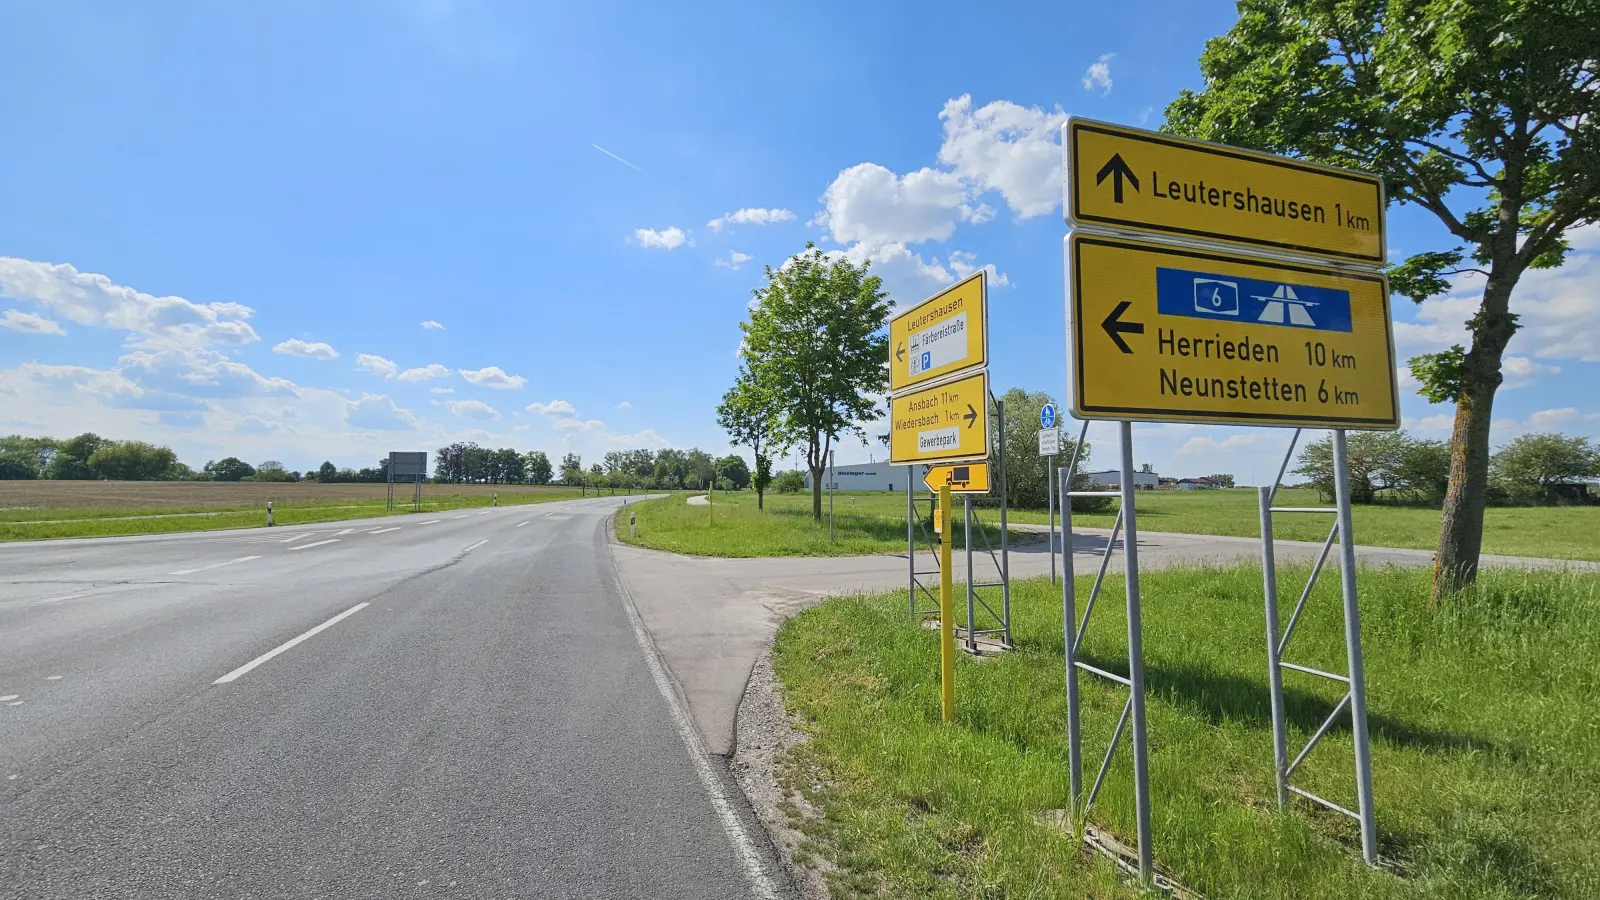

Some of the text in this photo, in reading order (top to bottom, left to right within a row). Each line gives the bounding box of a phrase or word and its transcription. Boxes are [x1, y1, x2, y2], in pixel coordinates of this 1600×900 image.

[1152, 170, 1370, 231] Leutershausen 1 km
[1211, 287, 1222, 307] 6
[908, 298, 963, 332] Leutershausen
[922, 319, 964, 347] Färbereistraße
[1158, 328, 1357, 370] Herrieden 10 km
[1160, 368, 1359, 405] Neunstetten 6 km
[908, 392, 959, 412] Ansbach 11 km
[895, 413, 939, 431] Wiedersbach
[950, 412, 960, 421] km
[920, 432, 957, 448] Gewerbepark
